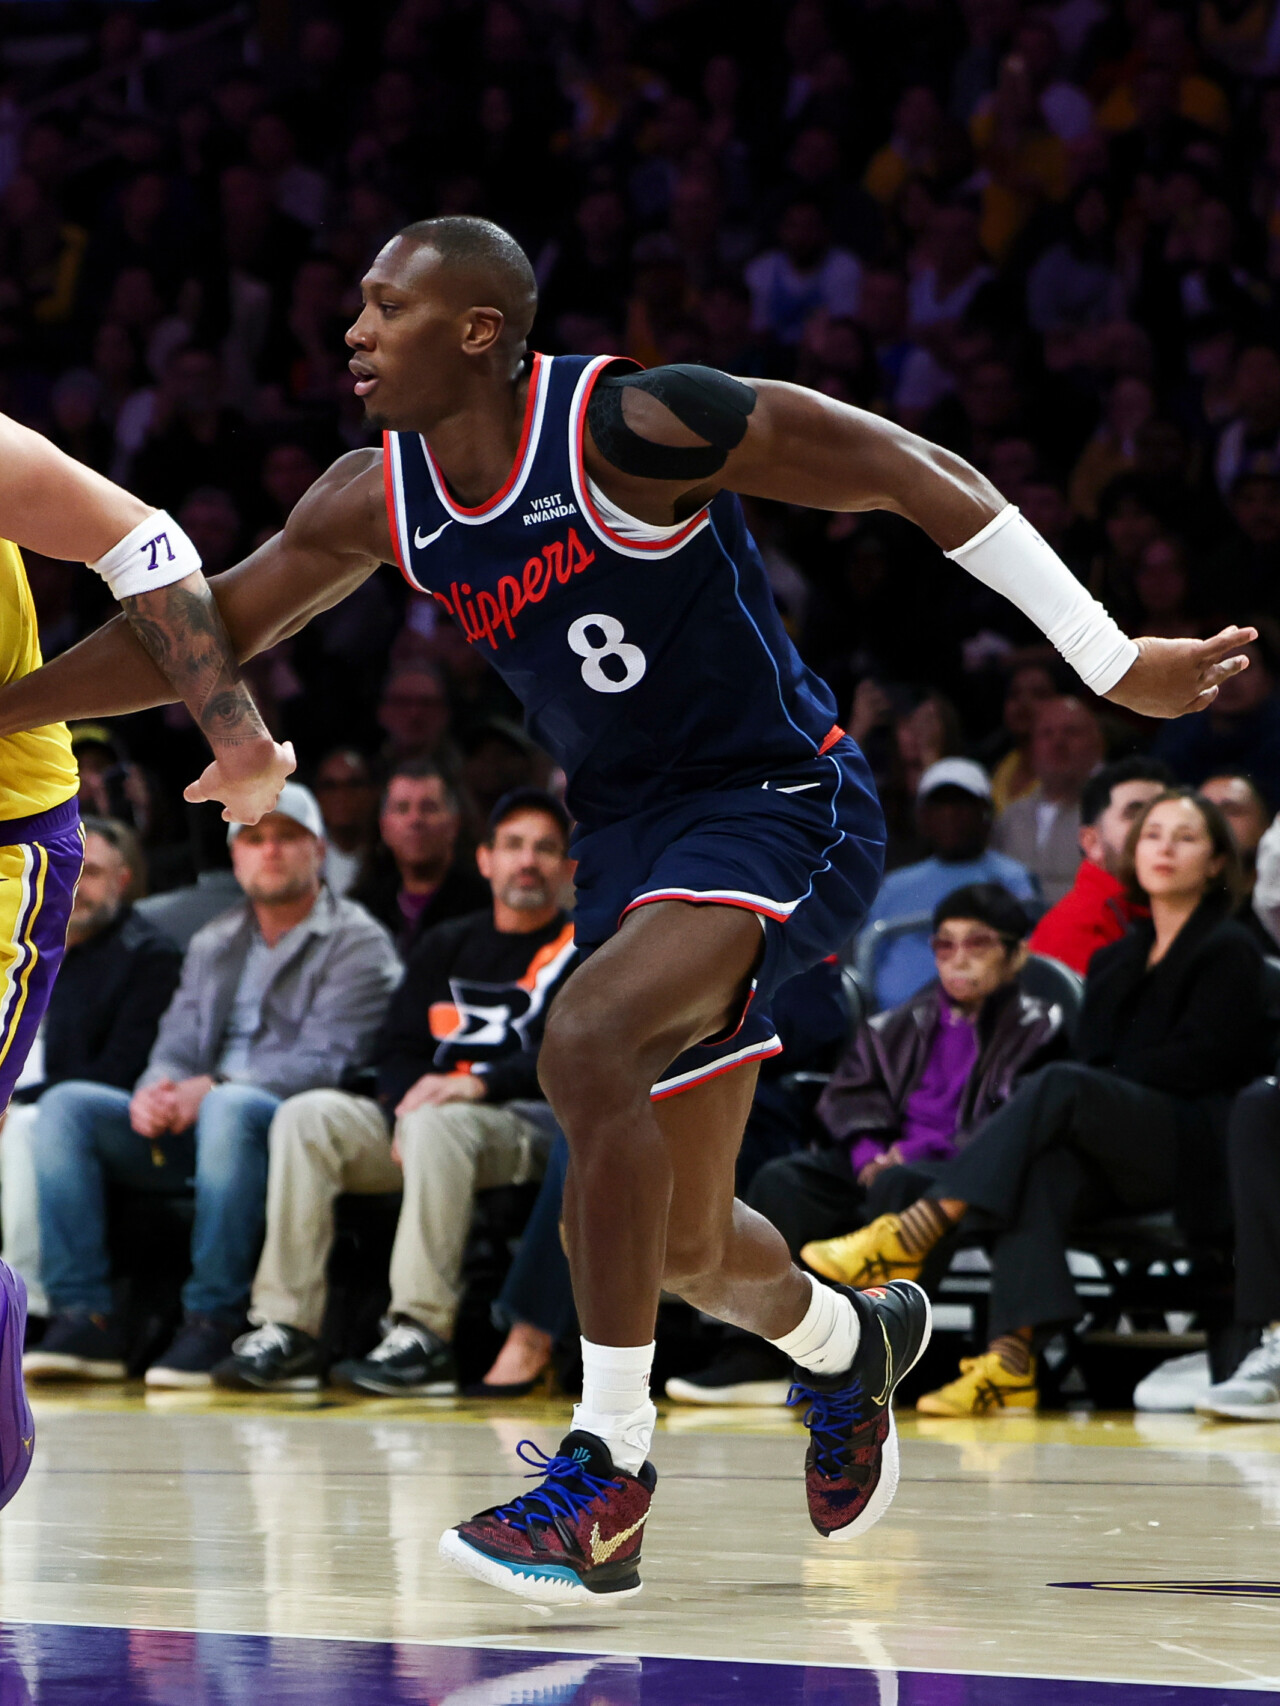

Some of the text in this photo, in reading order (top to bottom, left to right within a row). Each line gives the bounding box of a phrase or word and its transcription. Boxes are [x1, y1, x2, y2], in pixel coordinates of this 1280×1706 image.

[523, 503, 577, 526] RWANDA
[530, 493, 562, 511] VISIT
[140, 532, 176, 571] 77
[432, 527, 595, 650] lippers
[567, 613, 646, 693] 8
